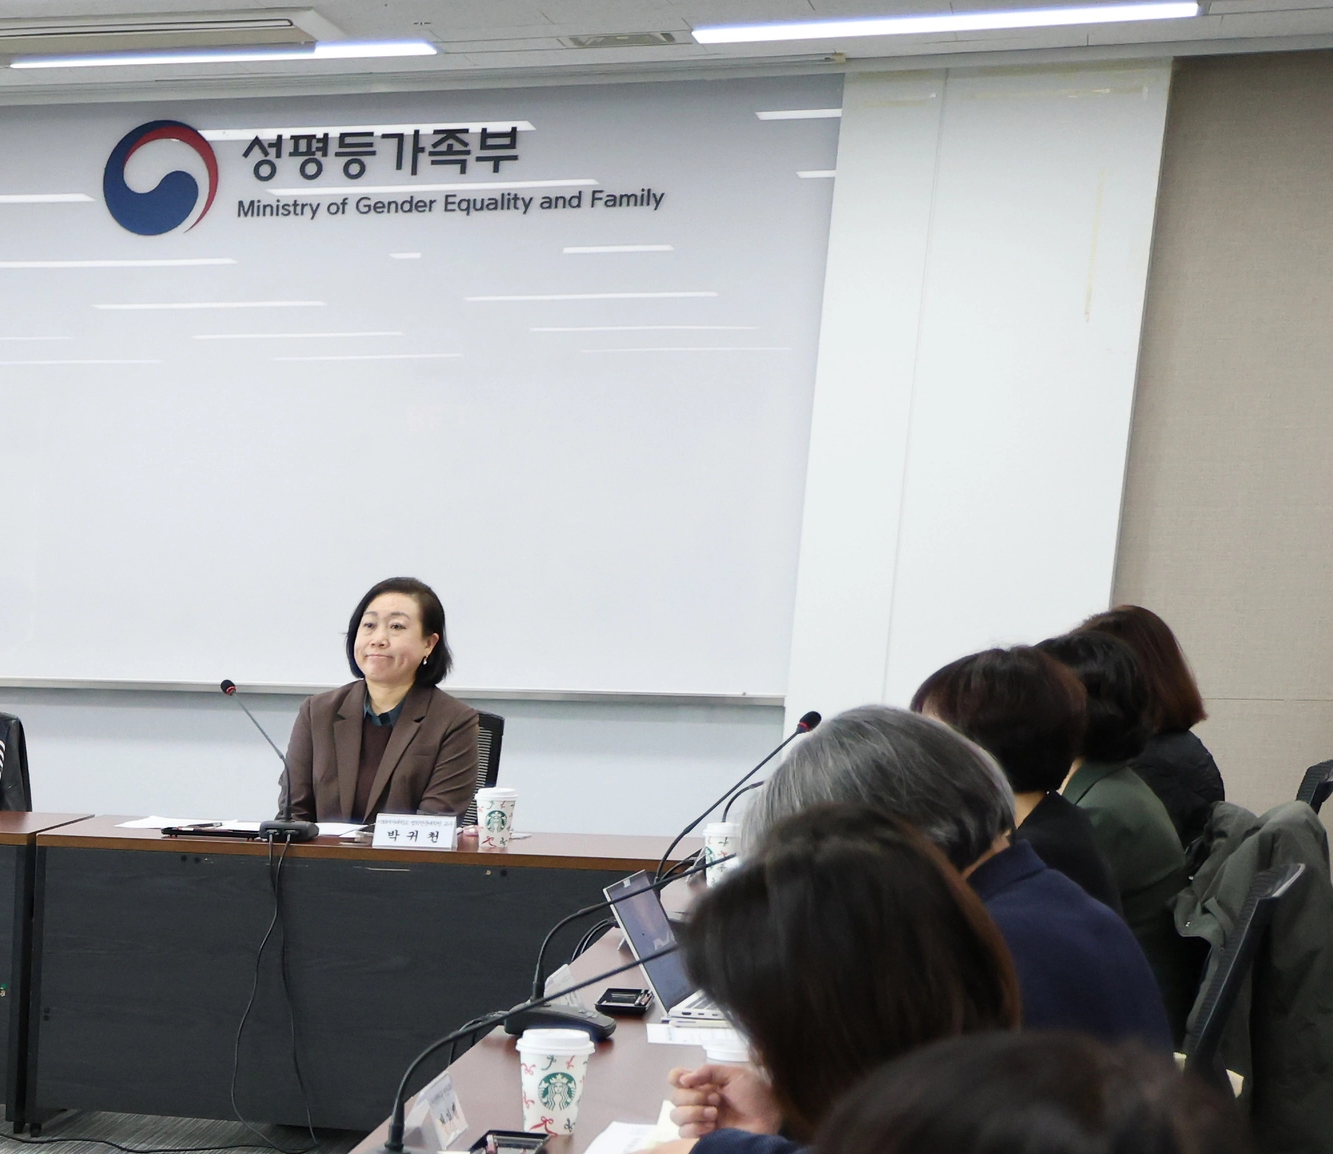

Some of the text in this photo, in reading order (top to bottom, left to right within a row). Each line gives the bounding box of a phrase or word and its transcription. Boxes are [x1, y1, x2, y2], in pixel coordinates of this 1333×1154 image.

[241, 126, 519, 182] 성평등가족부
[236, 187, 665, 219] Ministry of Gender Equality and Family
